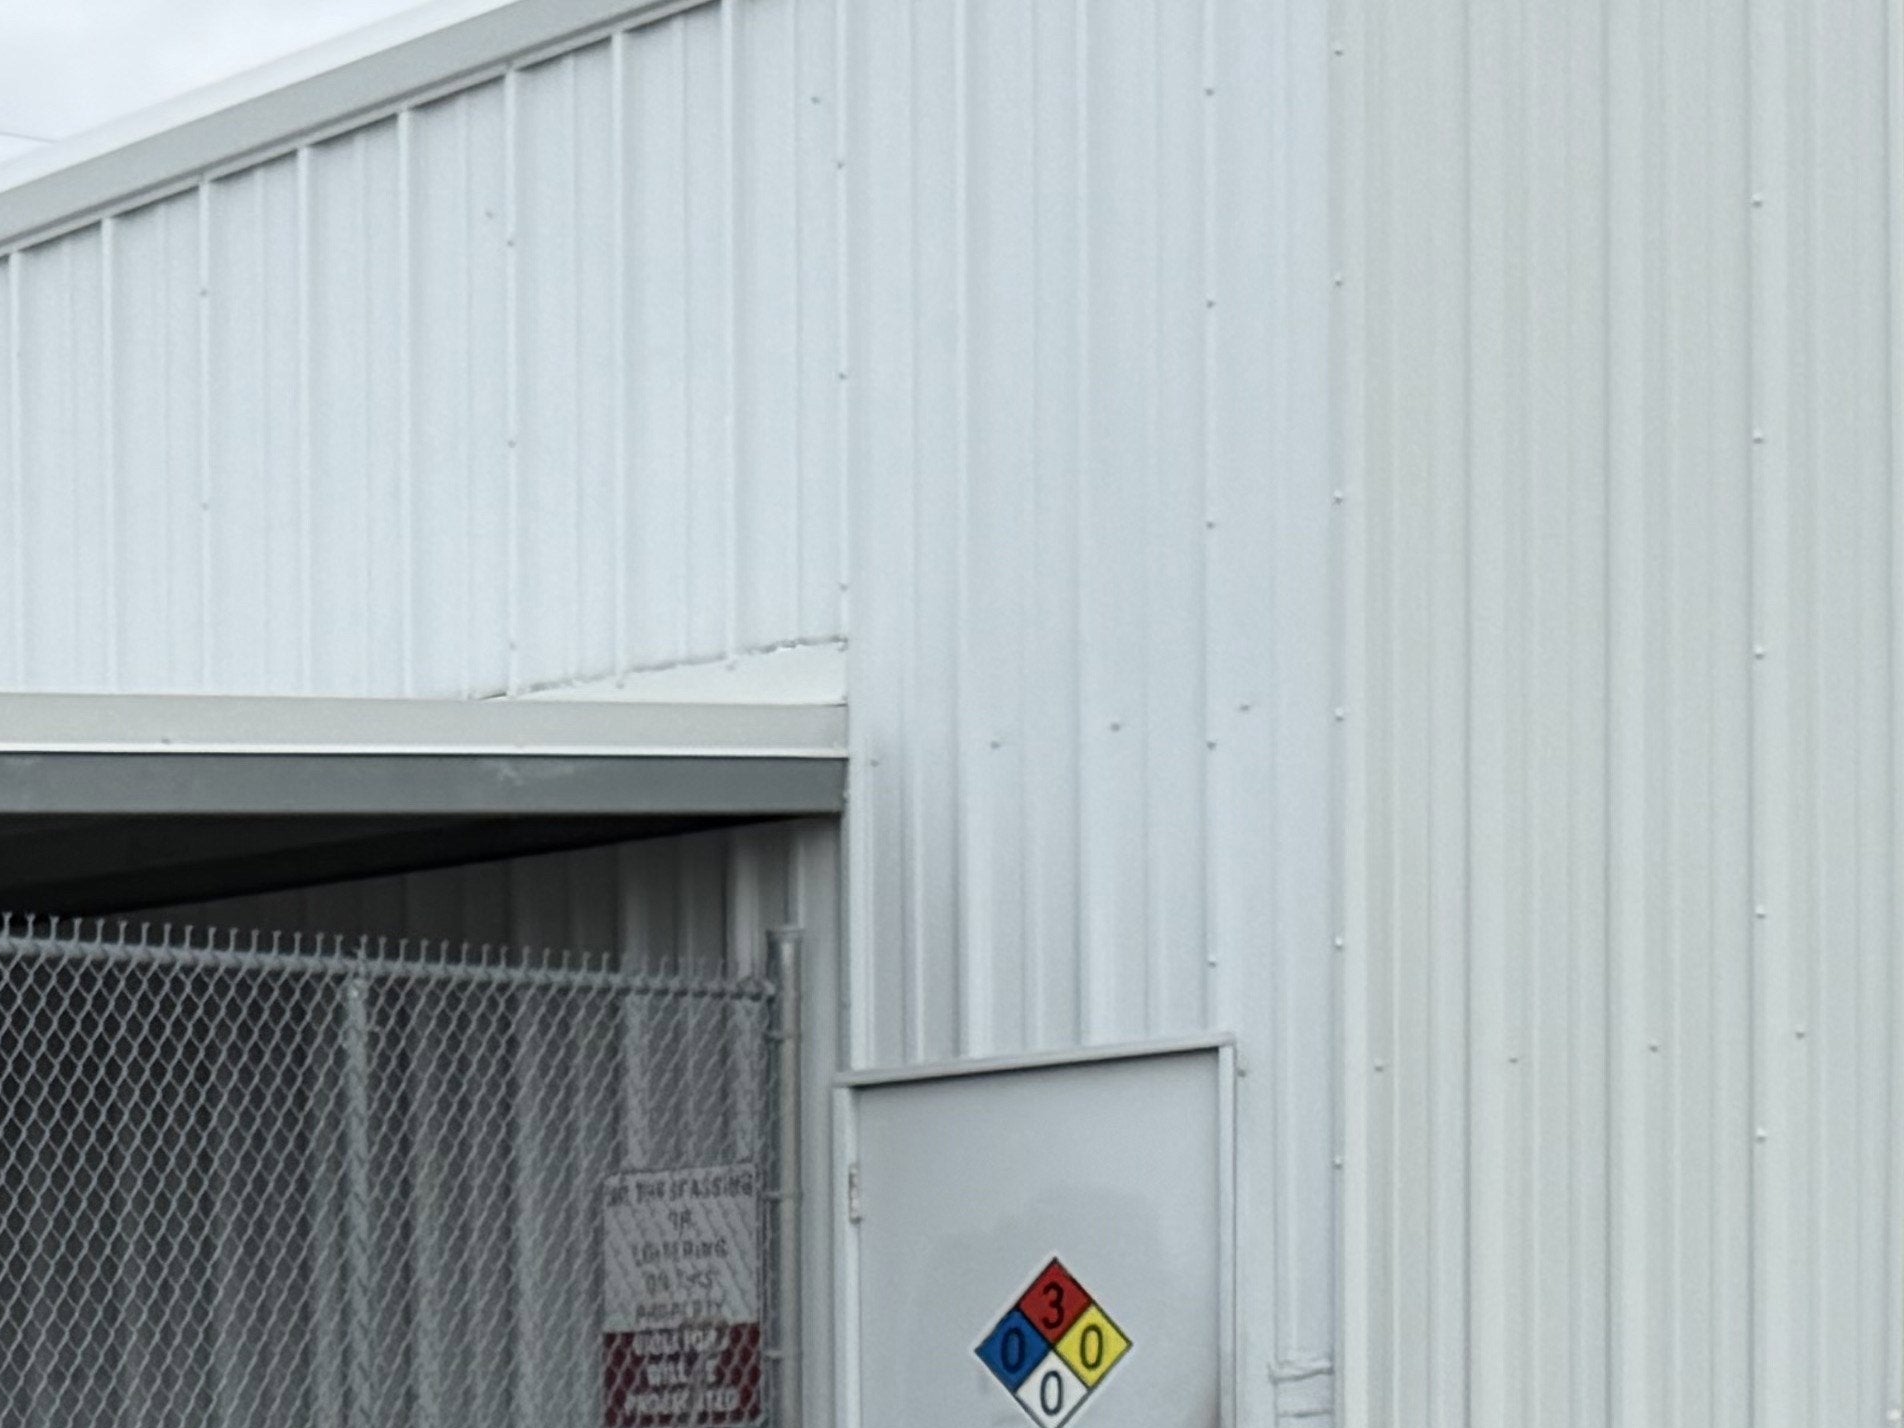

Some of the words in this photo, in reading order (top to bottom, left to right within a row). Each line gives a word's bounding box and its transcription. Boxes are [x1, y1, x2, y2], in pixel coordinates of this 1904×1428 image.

[1042, 1281, 1065, 1330] 3
[1001, 1327, 1025, 1374] 0
[1079, 1323, 1103, 1370] 0
[1040, 1370, 1064, 1416] 0
